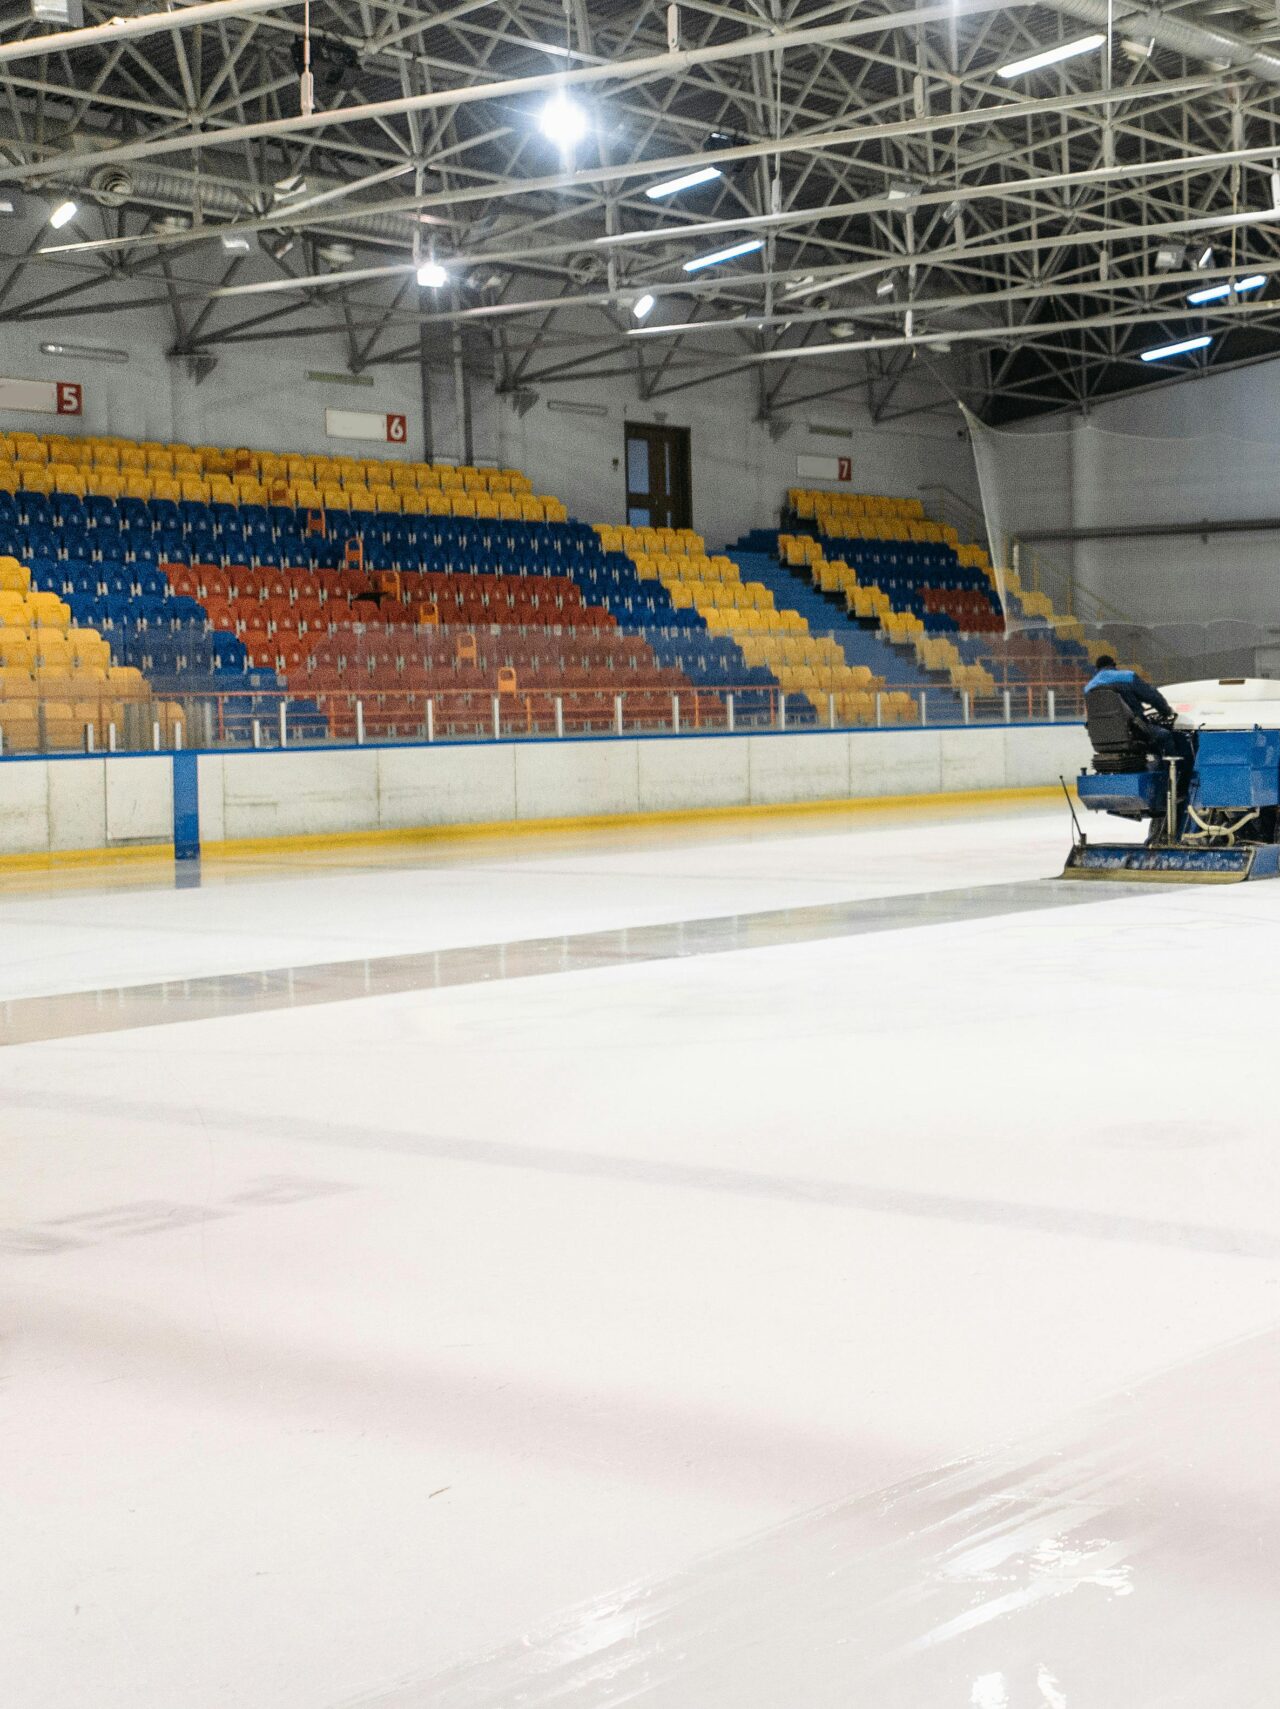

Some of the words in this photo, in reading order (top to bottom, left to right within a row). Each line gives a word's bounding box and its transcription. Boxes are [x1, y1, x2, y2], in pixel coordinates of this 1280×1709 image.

[62, 386, 79, 412] 5
[390, 417, 404, 440] 6
[840, 460, 849, 479] 7
